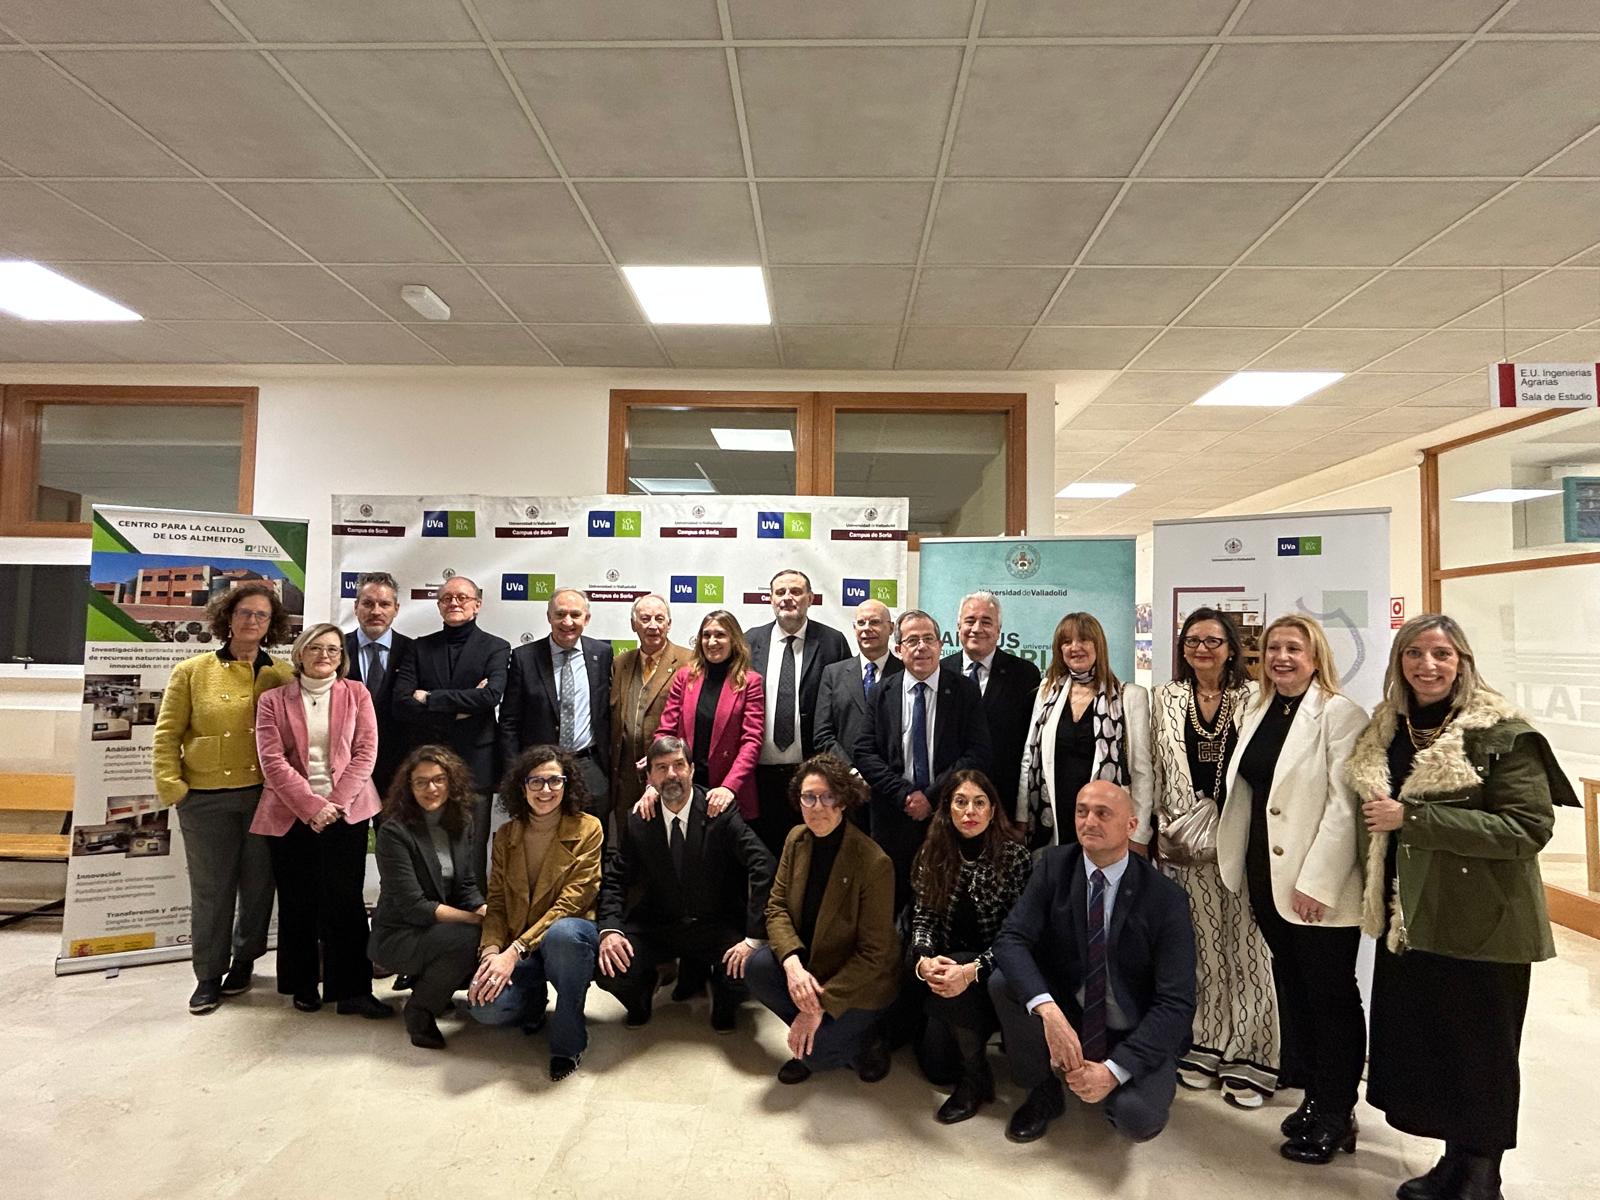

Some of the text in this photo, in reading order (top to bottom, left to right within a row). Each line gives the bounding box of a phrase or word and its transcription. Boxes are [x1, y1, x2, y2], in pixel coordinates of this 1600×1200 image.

[1520, 369, 1540, 377] E.U.
[1520, 378, 1559, 387] Agrarias
[1521, 392, 1593, 401] Sala de Estudio
[118, 520, 246, 534] CENTRO PARA LA CALIDAD
[426, 519, 444, 528] UVa
[592, 519, 611, 529] UVa
[761, 520, 780, 529] UVa
[347, 527, 368, 535] Campus
[153, 532, 245, 544] DE LOS ALIMENTOS
[506, 582, 524, 591] UVa
[674, 584, 693, 594] UVa
[846, 587, 865, 597] UVa
[1030, 589, 1068, 597] Valladolid
[106, 908, 159, 918] Transferencia
